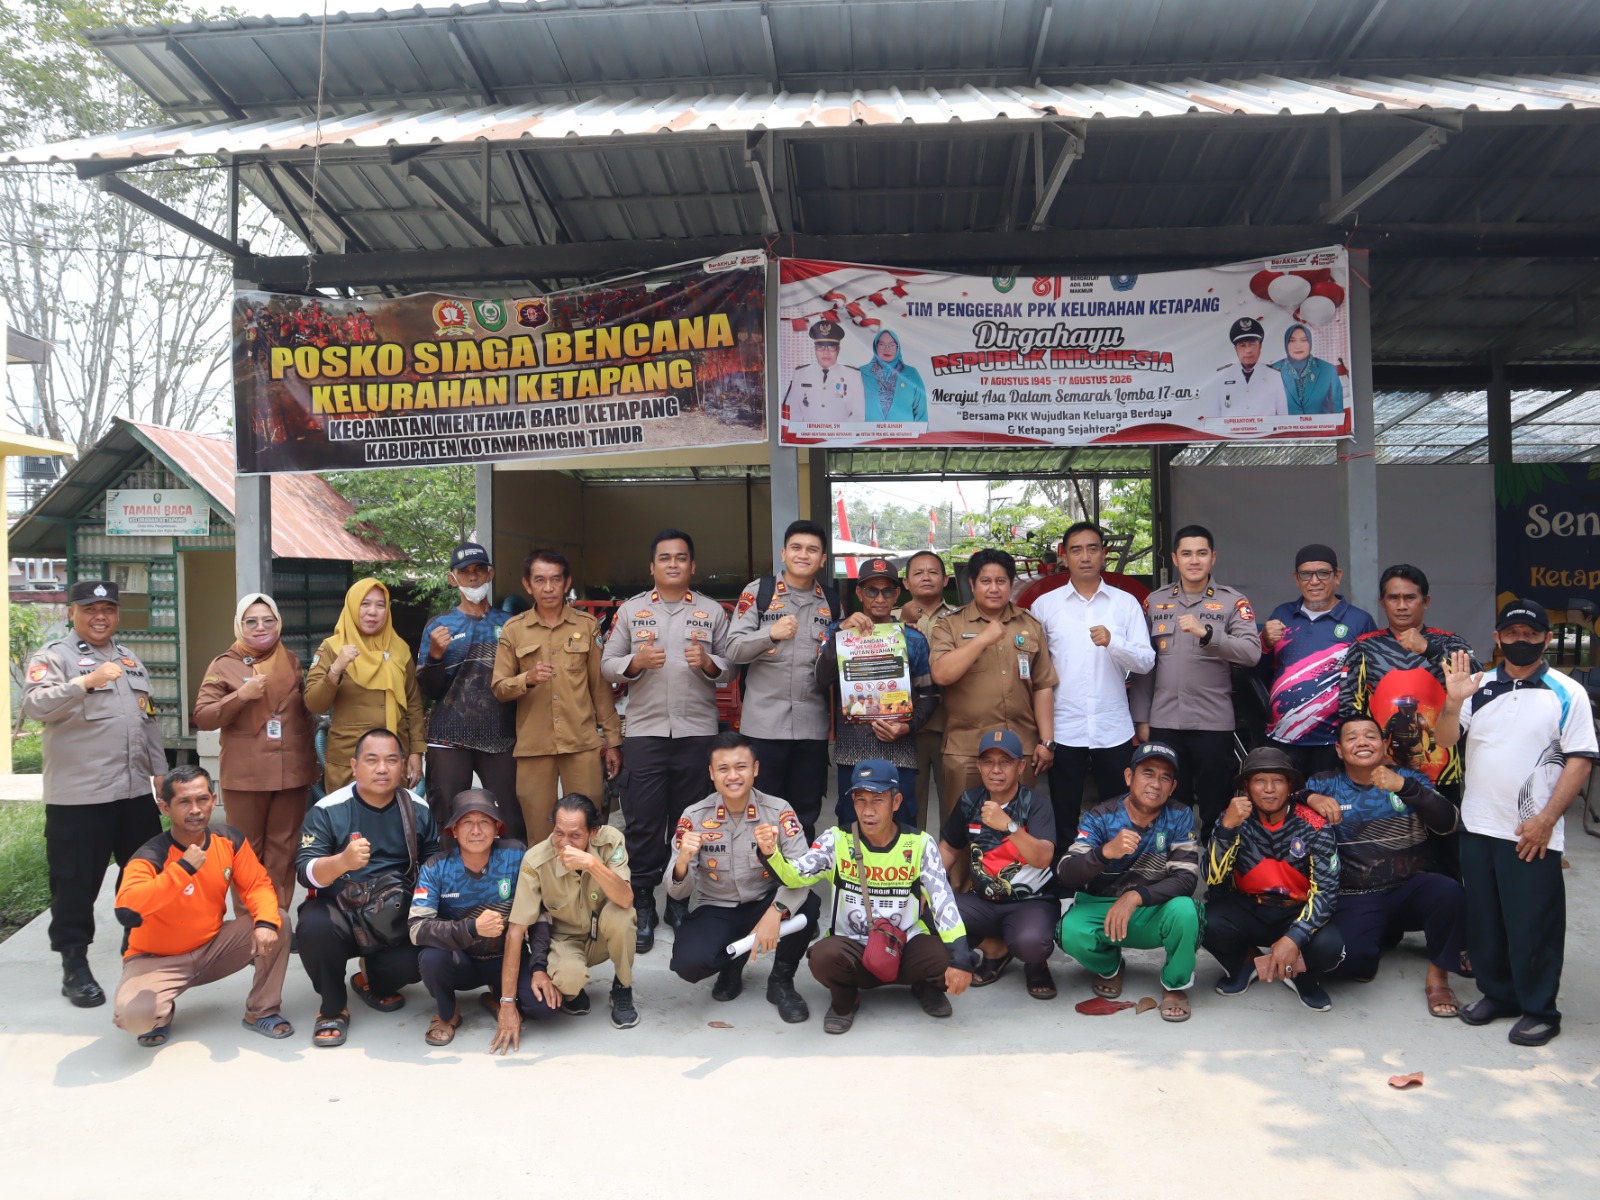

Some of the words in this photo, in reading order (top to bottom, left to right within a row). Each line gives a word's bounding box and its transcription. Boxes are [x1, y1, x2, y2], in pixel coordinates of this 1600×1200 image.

[906, 302, 933, 317] TIM
[937, 303, 1023, 317] PENGGERAK
[1028, 302, 1057, 317] PPK
[1061, 300, 1145, 317] KELURAHAN
[1150, 297, 1220, 315] KETAPANG
[271, 343, 404, 379] POSKO
[414, 335, 538, 374] SIAGA
[544, 313, 734, 366] BENCANA
[973, 321, 1124, 355] Dirgahayu
[931, 349, 1047, 376] REPUBLIK
[1051, 349, 1174, 373] INDONESIA
[312, 376, 508, 414] KELURAHAN
[517, 358, 693, 403] KETAPANG
[980, 377, 989, 386] 17
[991, 377, 1030, 386] AGUSTUS
[1031, 376, 1052, 385] 1945
[1058, 376, 1067, 385] 17
[1069, 375, 1108, 385] AGUSTUS
[1110, 375, 1132, 384] 2026
[932, 388, 979, 406] Merajut
[981, 389, 1006, 404] Asa
[1009, 389, 1052, 403] Dalam
[1055, 388, 1112, 402] Semarak
[1114, 387, 1155, 405] Lomba
[1158, 386, 1192, 399] 17-an
[329, 416, 433, 440] KECAMATAN
[436, 410, 526, 435] MENTAWA
[531, 405, 580, 427] BARU
[584, 398, 679, 423] KETAPANG
[1007, 411, 1028, 421] PKK
[1031, 411, 1081, 422] Wujudkan
[1083, 410, 1128, 421] Keluarga
[1130, 408, 1172, 419] Berdaya
[1008, 425, 1015, 435] &
[1018, 425, 1065, 436] Ketapang
[366, 439, 456, 461] KABUPATEN
[460, 431, 586, 455] KOTAWARINGIN
[589, 426, 643, 446] TIMUR
[123, 505, 160, 516] TAMAN
[164, 505, 193, 516] BACA
[686, 620, 713, 628] POLRI
[814, 617, 832, 627] POL
[1200, 613, 1224, 621] POLRI
